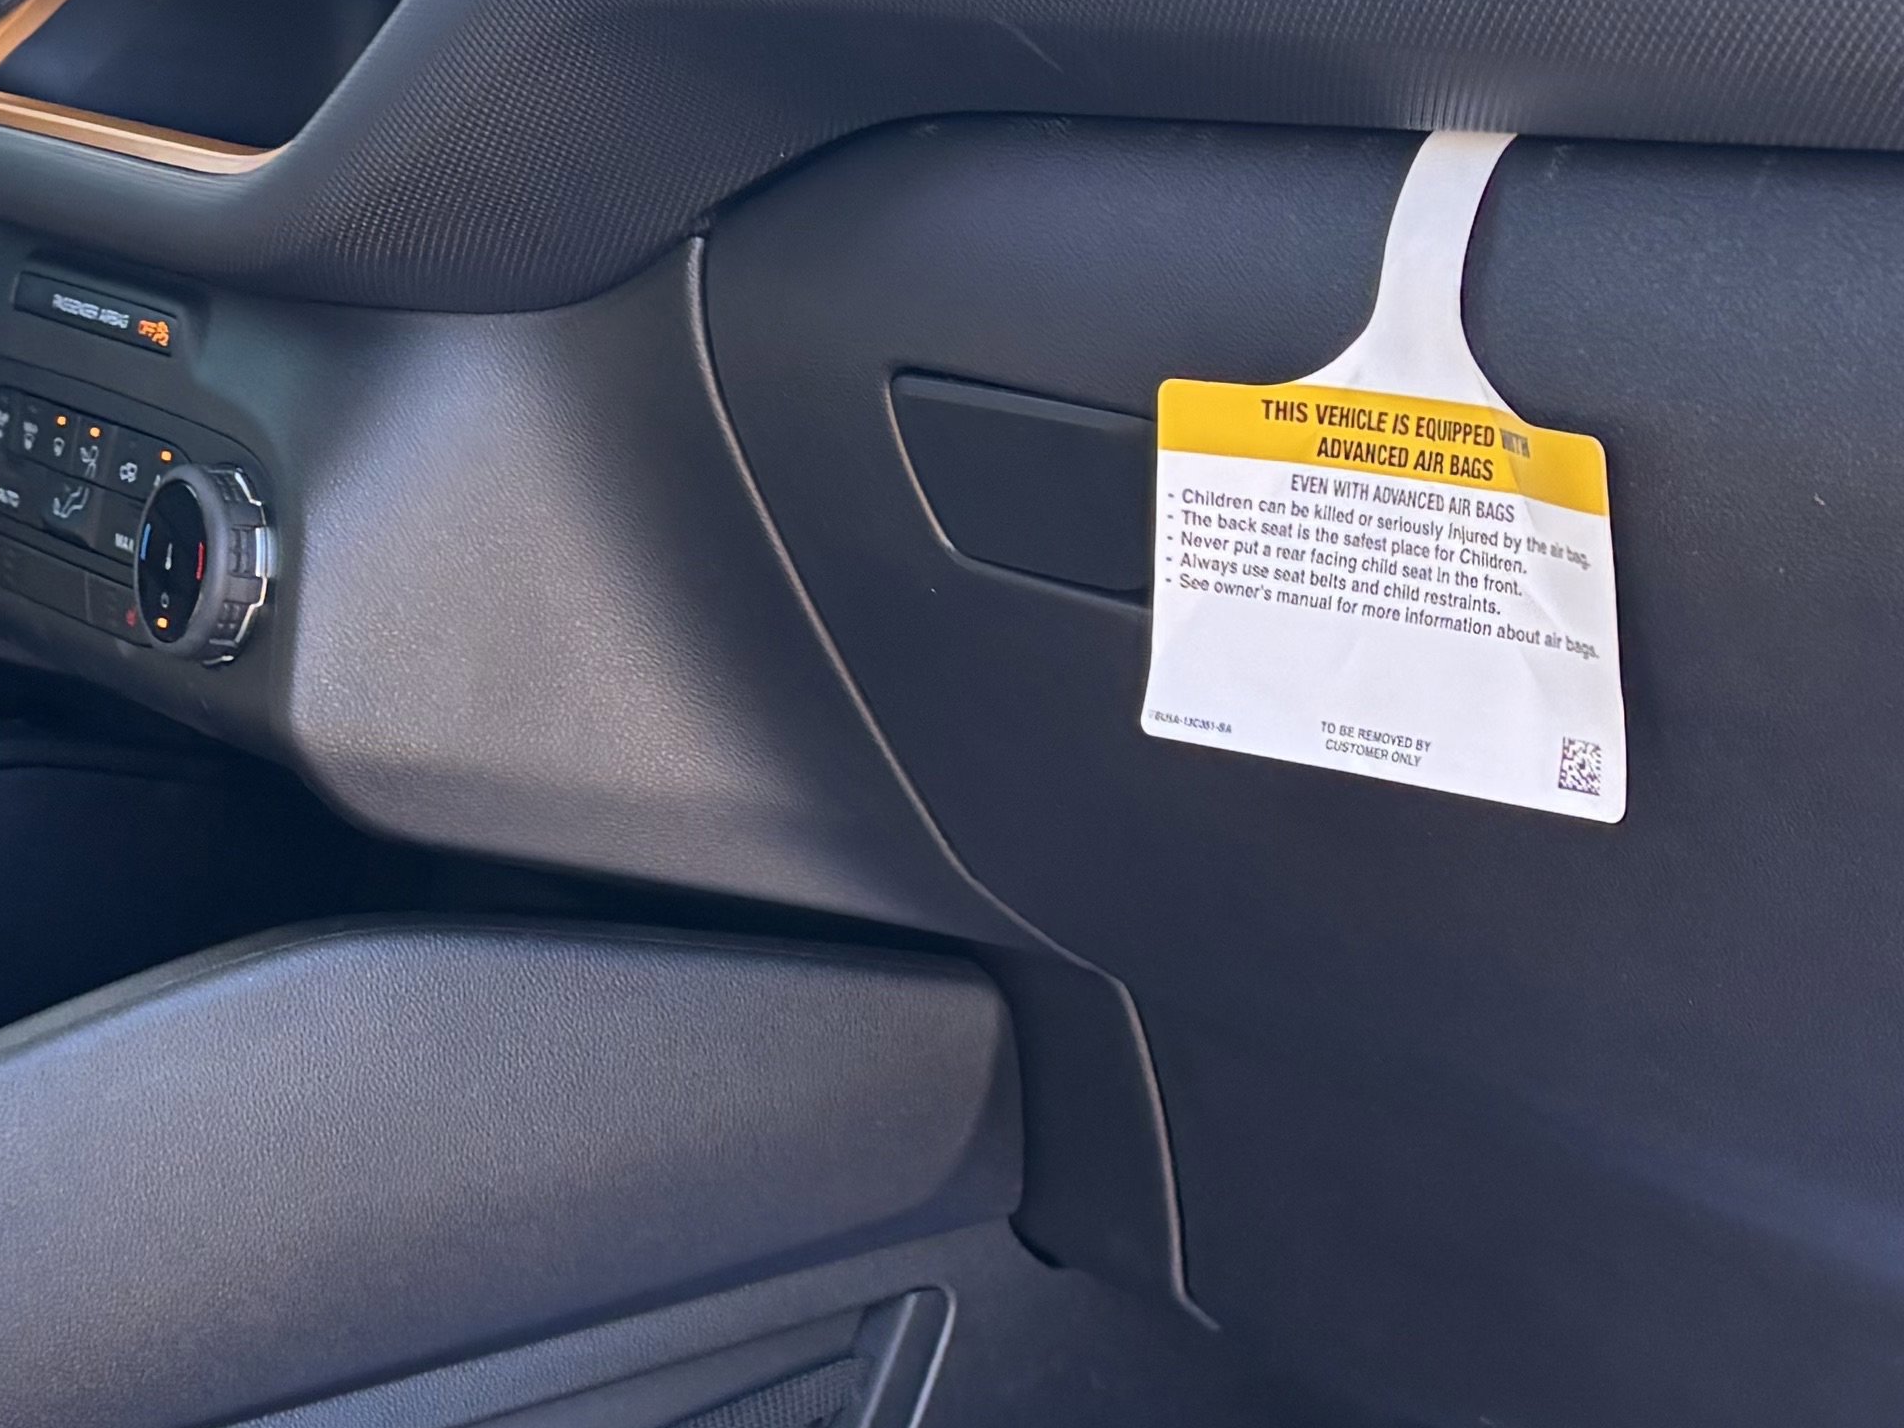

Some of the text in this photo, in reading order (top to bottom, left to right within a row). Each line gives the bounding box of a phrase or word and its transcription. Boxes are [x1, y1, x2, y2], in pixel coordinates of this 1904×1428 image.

[1262, 399, 1308, 423] THIS
[1315, 403, 1389, 433] VEHICLE
[1392, 413, 1410, 435] IS
[1416, 416, 1495, 447] EQUIPPED
[1317, 437, 1495, 481] ADVANCED AIR BAGS
[1182, 488, 1253, 511] Children
[1258, 499, 1286, 515] can
[1291, 501, 1309, 518] be
[1314, 503, 1355, 525] killed
[1358, 513, 1373, 527] or
[1377, 515, 1443, 541] seriously
[1503, 532, 1522, 554] by
[1527, 538, 1547, 554] the
[1291, 474, 1515, 523] EVEN WITH ADVANCED AIR BAGS
[1181, 531, 1522, 597] Never put a rear facing child seat in the front.
[1182, 510, 1527, 574] The back seat is the safest place for Children.
[1180, 552, 1501, 615] Always use seat belts and child restraints.
[1180, 573, 1209, 591] See
[1214, 580, 1272, 601] owner's
[1276, 590, 1332, 611] manual
[1337, 597, 1358, 615] for
[1362, 603, 1400, 622] more
[1405, 607, 1492, 636] information
[1497, 623, 1541, 645] about
[1544, 633, 1562, 649] air
[1321, 721, 1431, 752] TO BE REMOVED BY
[1325, 739, 1422, 767] CUSTOMER ONLY
